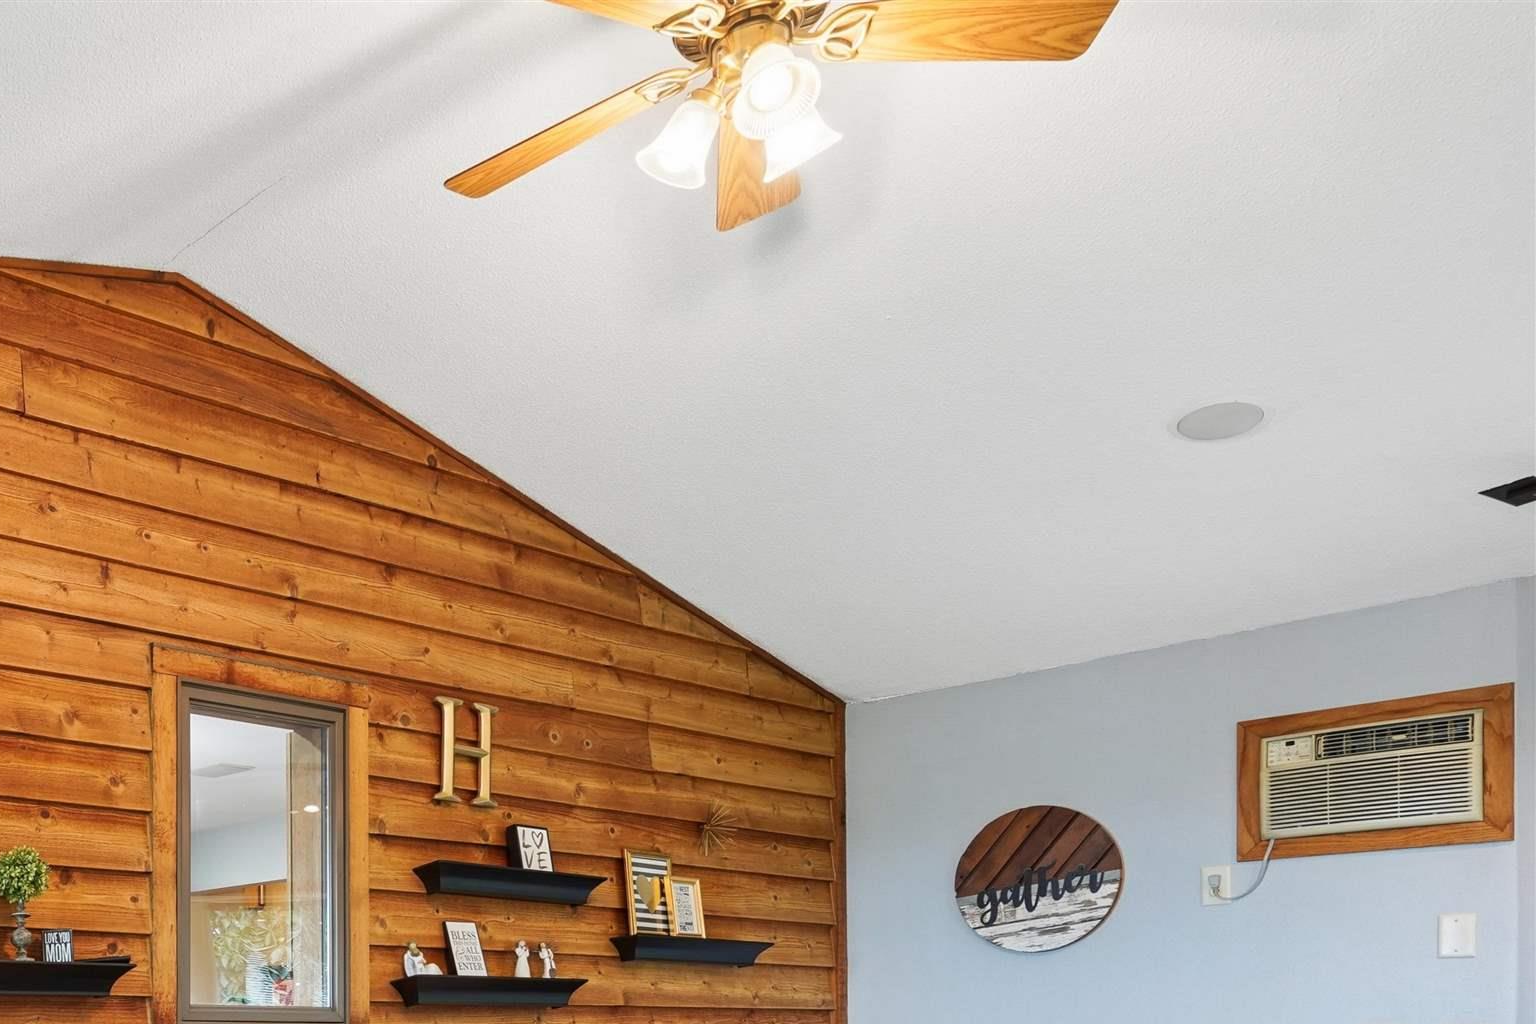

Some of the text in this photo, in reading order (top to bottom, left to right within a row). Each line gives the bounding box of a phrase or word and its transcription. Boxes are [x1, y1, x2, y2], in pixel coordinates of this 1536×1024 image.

[431, 695, 500, 808] H
[977, 860, 1105, 926] gather
[44, 931, 71, 944] LOVE YOU
[450, 930, 476, 940] BLESS
[46, 943, 72, 962] MOM
[466, 946, 480, 954] ALL
[458, 962, 483, 970] ENTER
